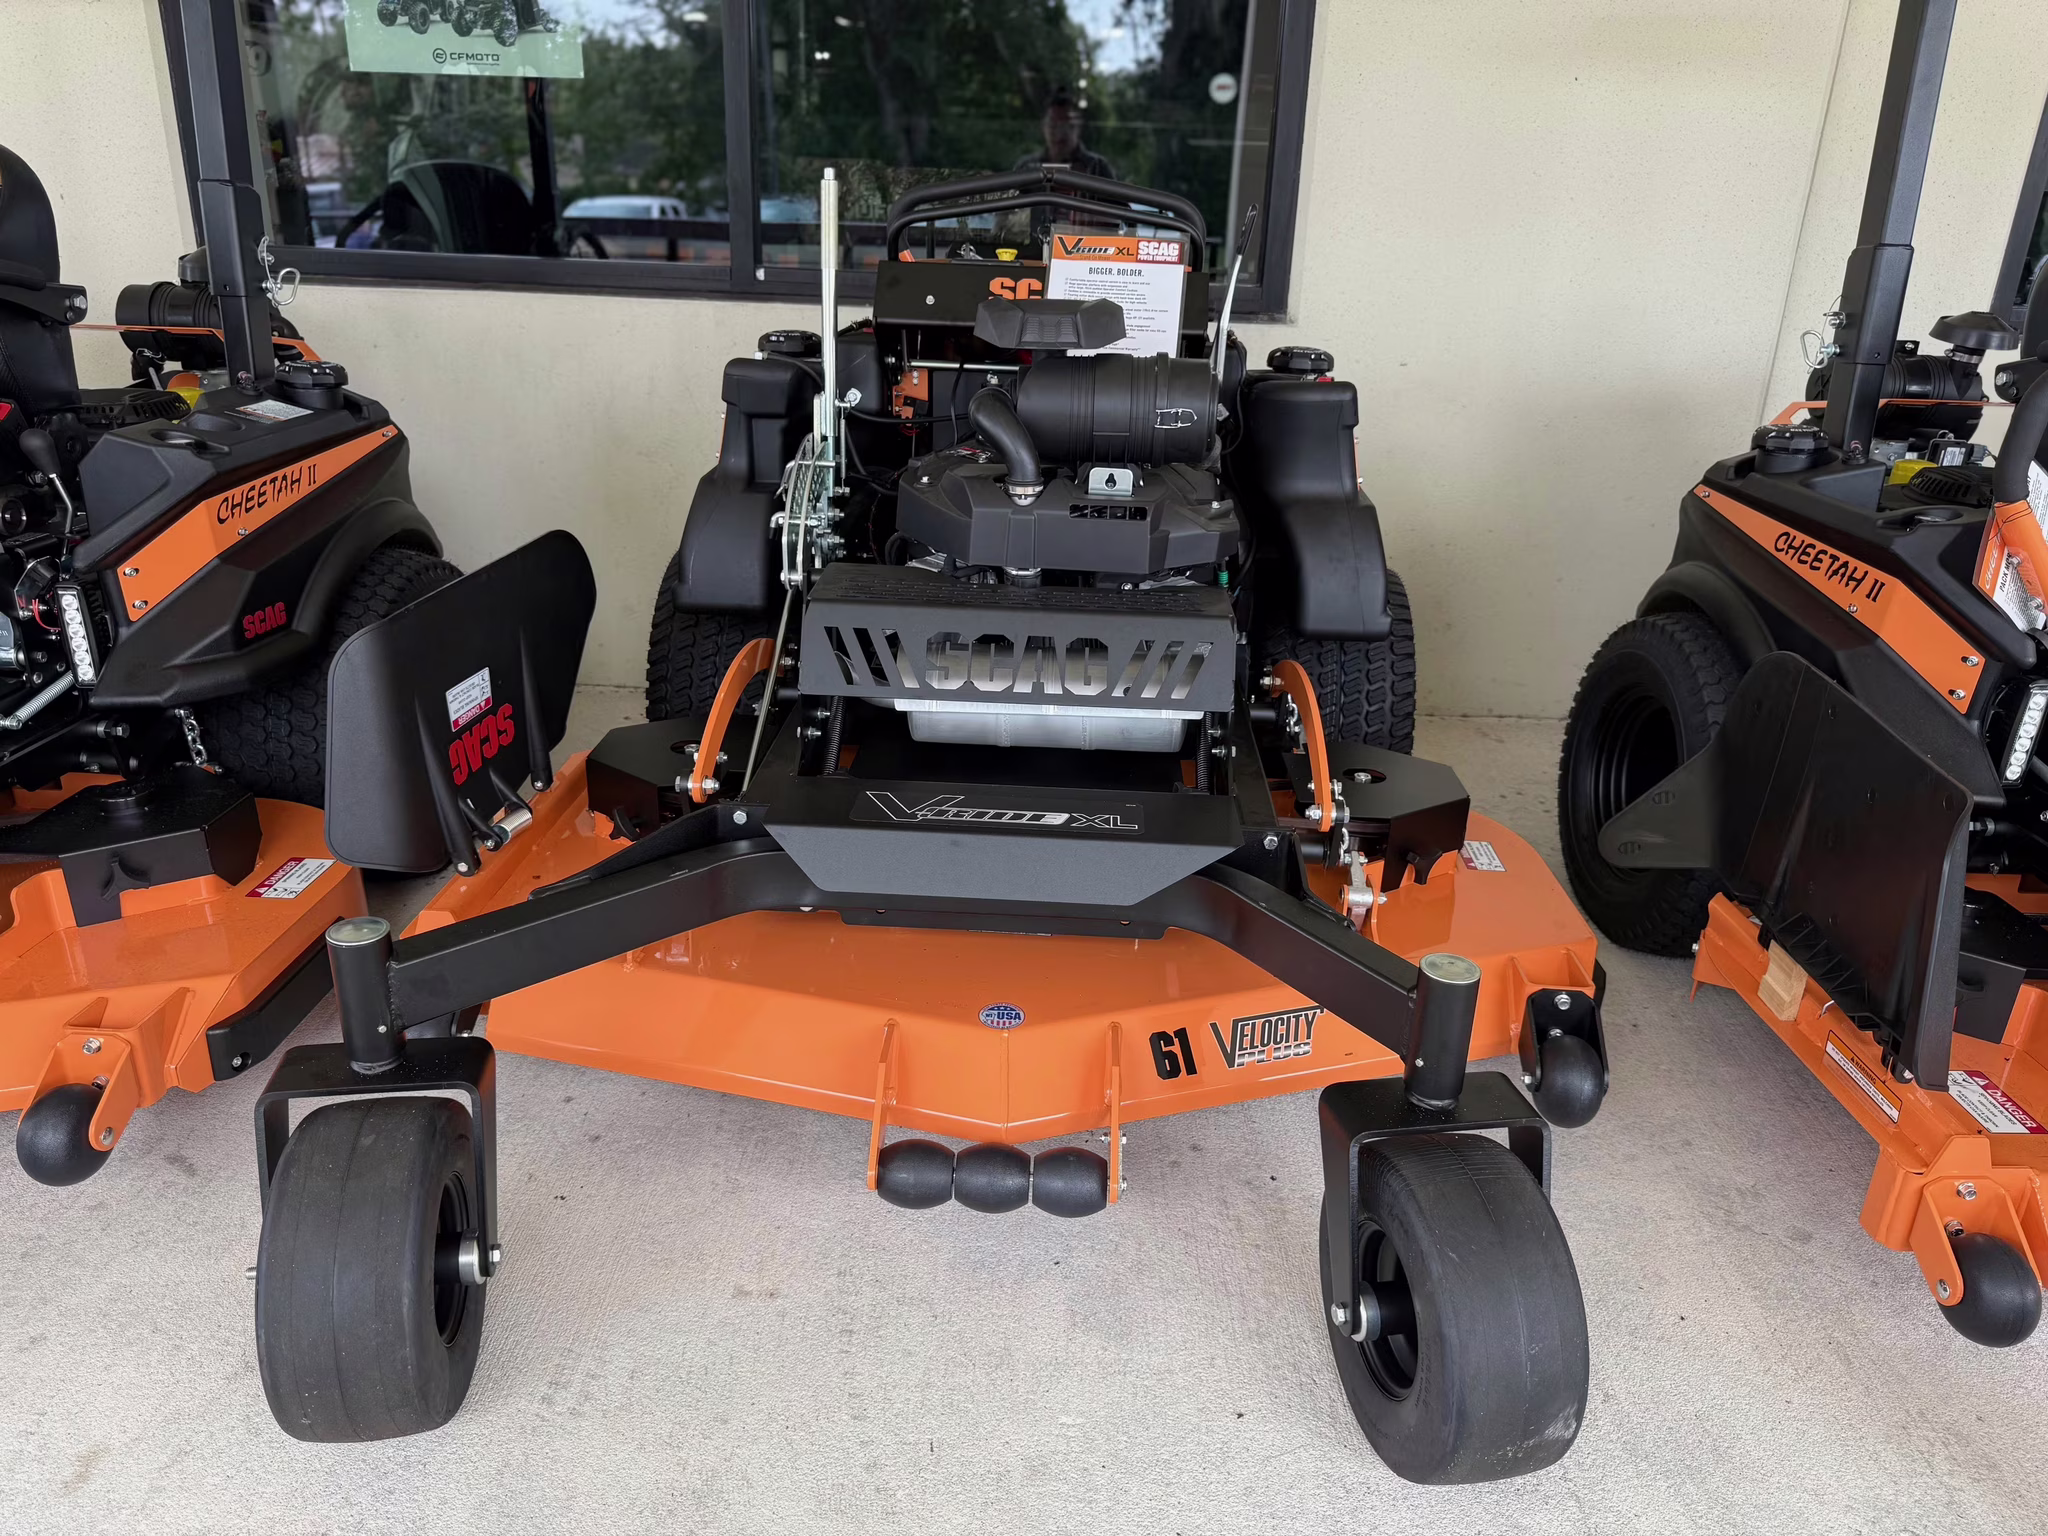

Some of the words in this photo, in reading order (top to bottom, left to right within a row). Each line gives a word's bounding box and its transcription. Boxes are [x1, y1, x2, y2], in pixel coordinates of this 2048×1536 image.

[449, 52, 500, 62] CFMOTO
[1116, 247, 1134, 256] XL
[1138, 241, 1179, 256] SCAG
[1088, 267, 1115, 276] BIGGER.
[1116, 268, 1144, 277] BOLDER.
[217, 466, 303, 524] CHEETAH
[308, 464, 316, 486] II
[1774, 532, 1868, 594] CHEETAH
[1866, 578, 1886, 602] II
[243, 602, 286, 638] SCAG
[925, 632, 1109, 696] SCAG
[458, 704, 479, 725] DANGER
[449, 703, 514, 785] SCAG
[1070, 813, 1138, 830] XL
[264, 861, 300, 884] DANGER
[997, 1012, 1022, 1020] USA
[1209, 1005, 1324, 1069] VELOCITY
[1149, 1027, 1198, 1080] 61
[1236, 1042, 1311, 1067] PLUS
[1855, 1060, 1877, 1084] WARNING
[1986, 1089, 2036, 1128] DANGER
